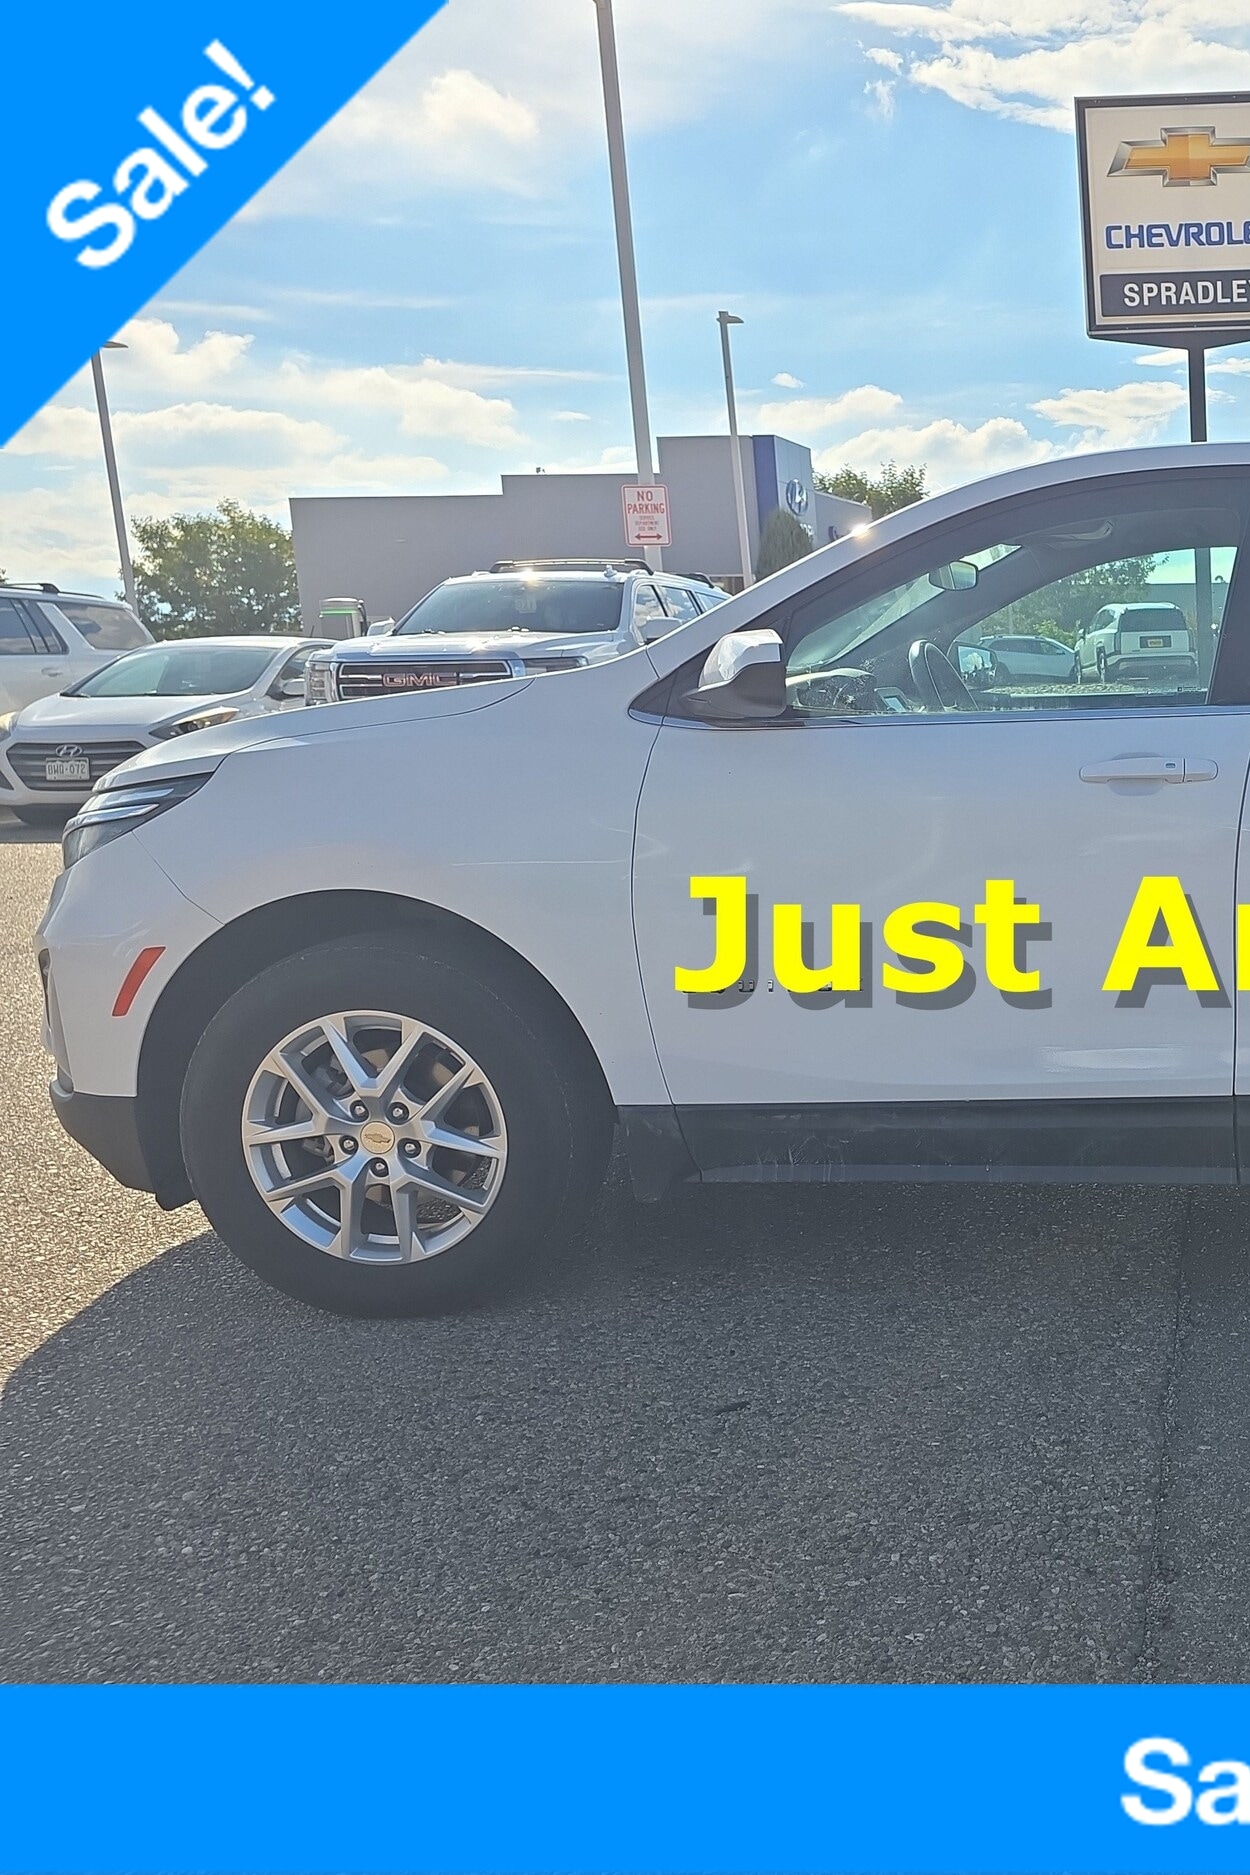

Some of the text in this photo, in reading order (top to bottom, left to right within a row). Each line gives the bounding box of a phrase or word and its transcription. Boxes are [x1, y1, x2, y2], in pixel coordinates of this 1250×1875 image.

[637, 491, 653, 501] NO
[627, 503, 665, 514] PARKING
[382, 672, 457, 687] GMC
